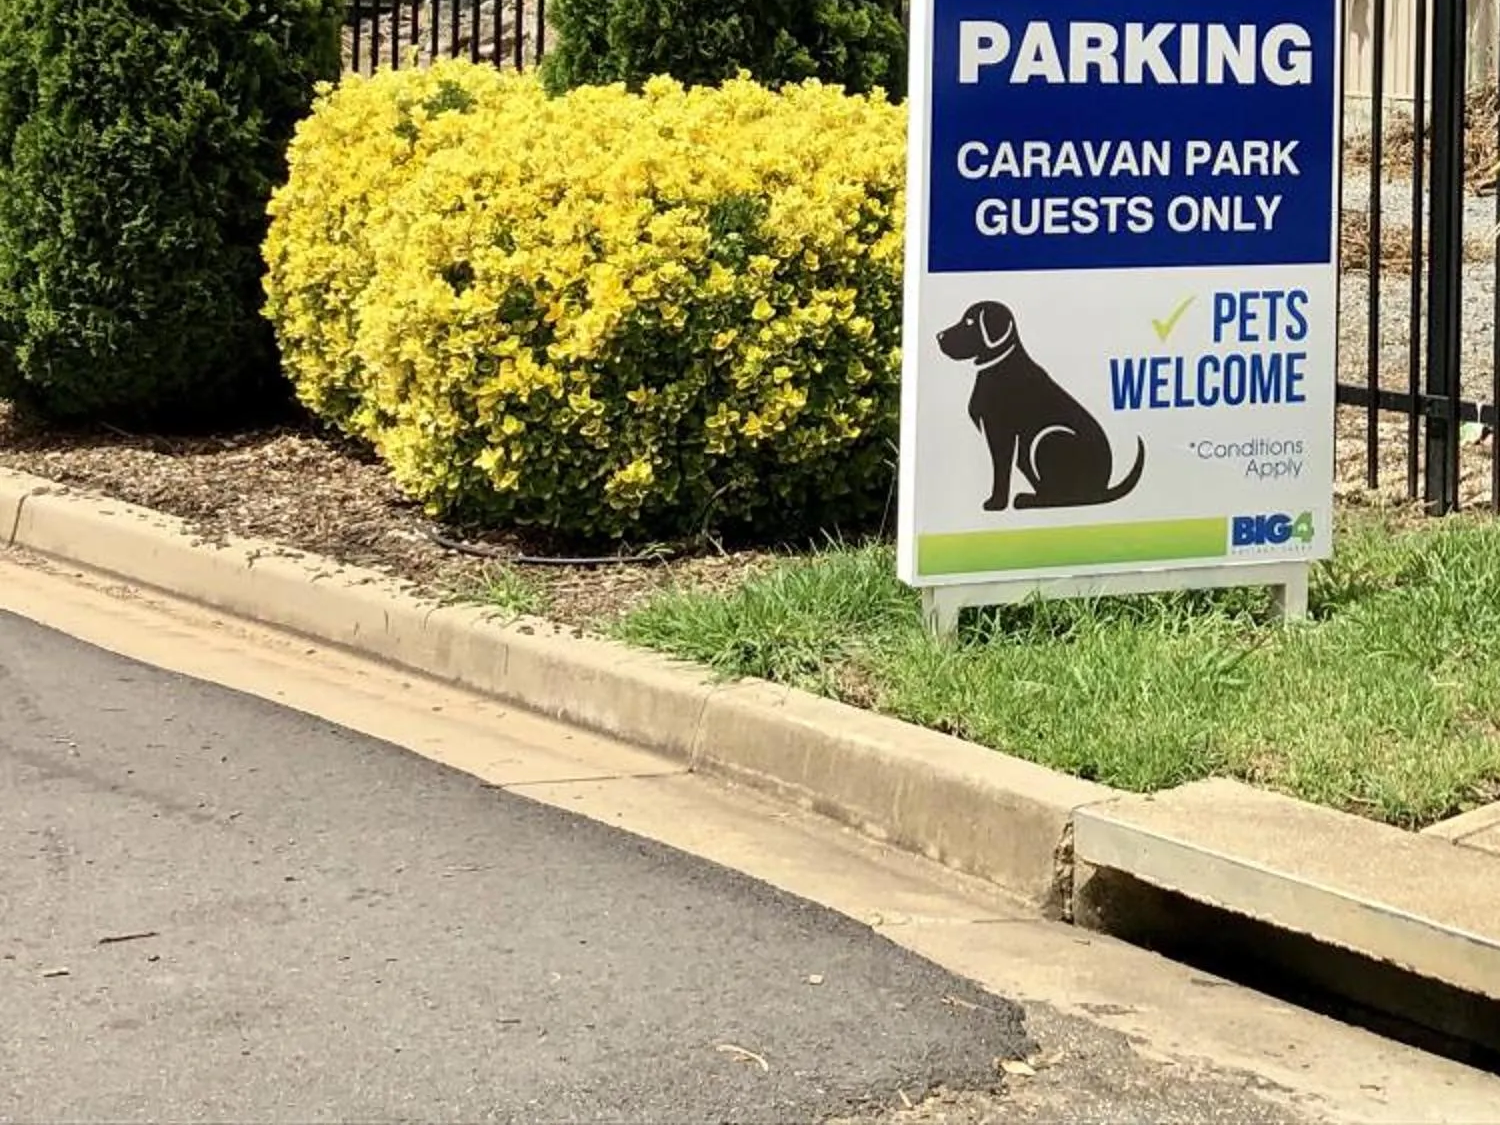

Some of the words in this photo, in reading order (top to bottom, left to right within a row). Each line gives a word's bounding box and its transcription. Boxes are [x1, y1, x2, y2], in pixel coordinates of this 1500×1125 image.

[958, 20, 1313, 86] PARKING
[957, 140, 1171, 179] CARAVAN
[1185, 140, 1300, 176] PARK
[975, 196, 1154, 236] GUESTS
[1167, 195, 1282, 232] ONLY
[1213, 289, 1309, 344] PETS
[1109, 352, 1307, 411] WELCOME
[1245, 456, 1304, 480] Apply
[1232, 510, 1315, 546] BIG4
